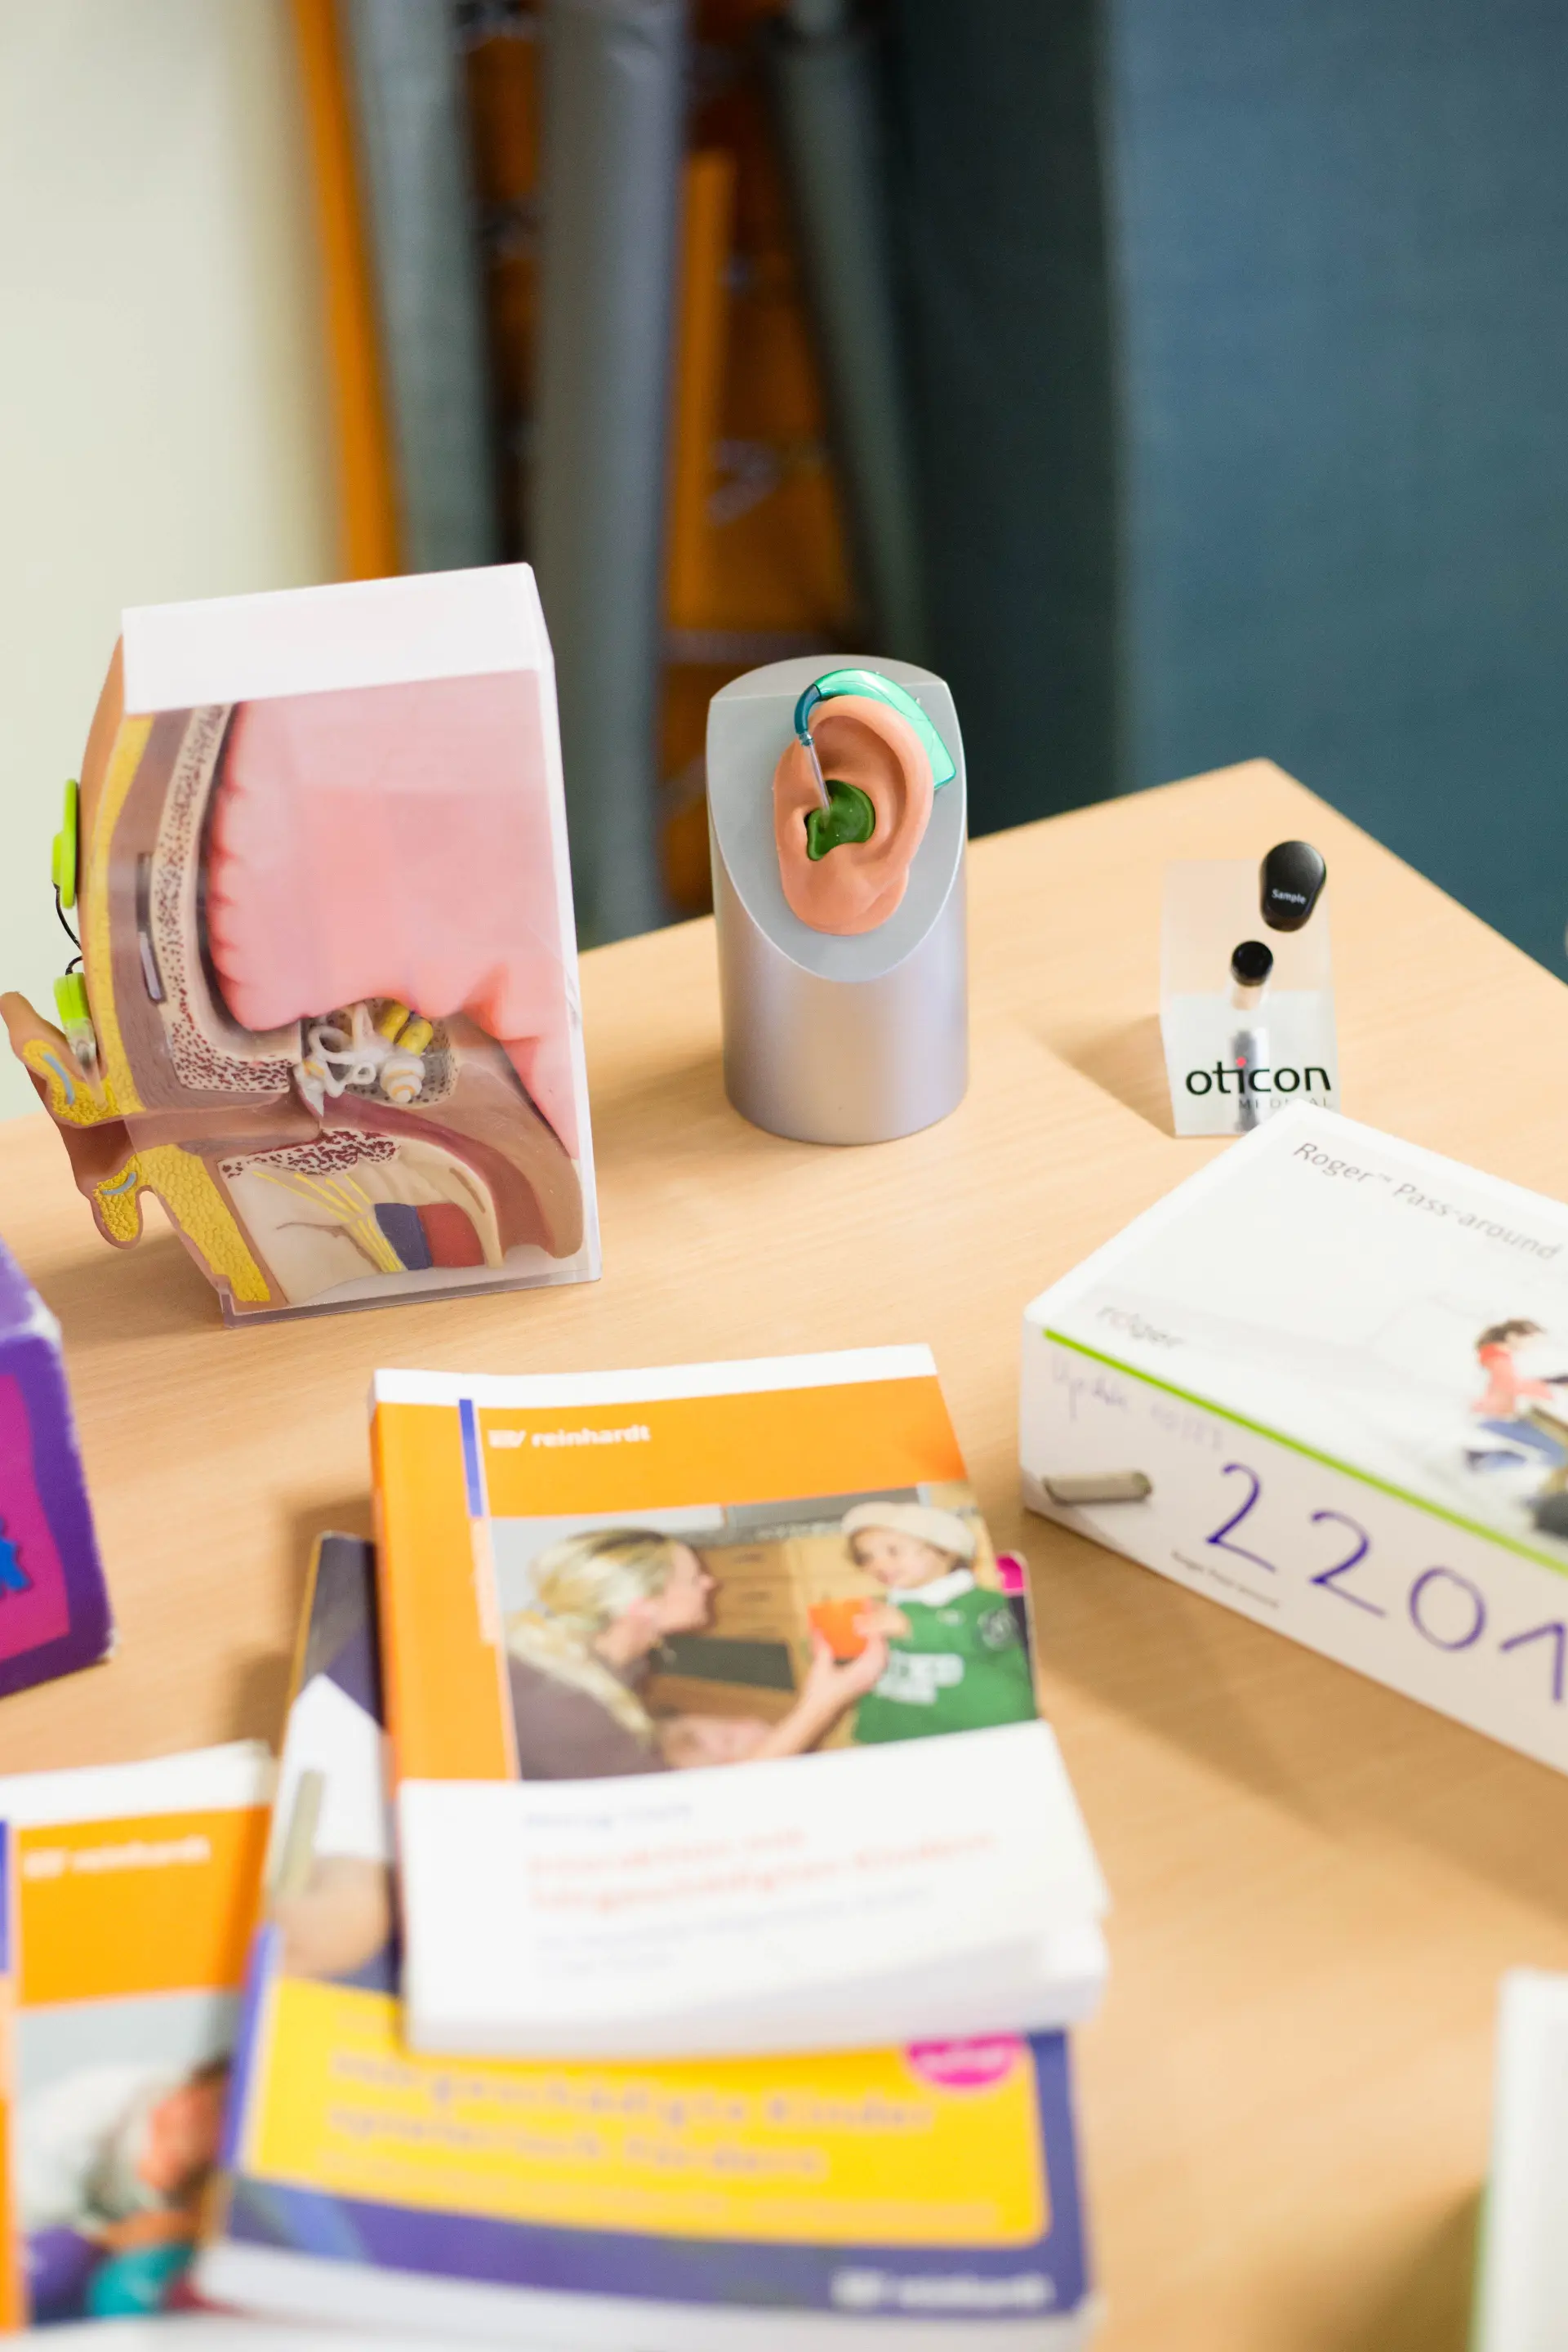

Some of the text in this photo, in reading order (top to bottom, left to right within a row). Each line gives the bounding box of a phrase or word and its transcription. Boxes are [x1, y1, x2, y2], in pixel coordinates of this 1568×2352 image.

[1272, 888, 1306, 904] Sample
[1185, 1057, 1331, 1095] oticon
[1392, 1183, 1564, 1260] Pass-around
[531, 1423, 652, 1449] reinhardt
